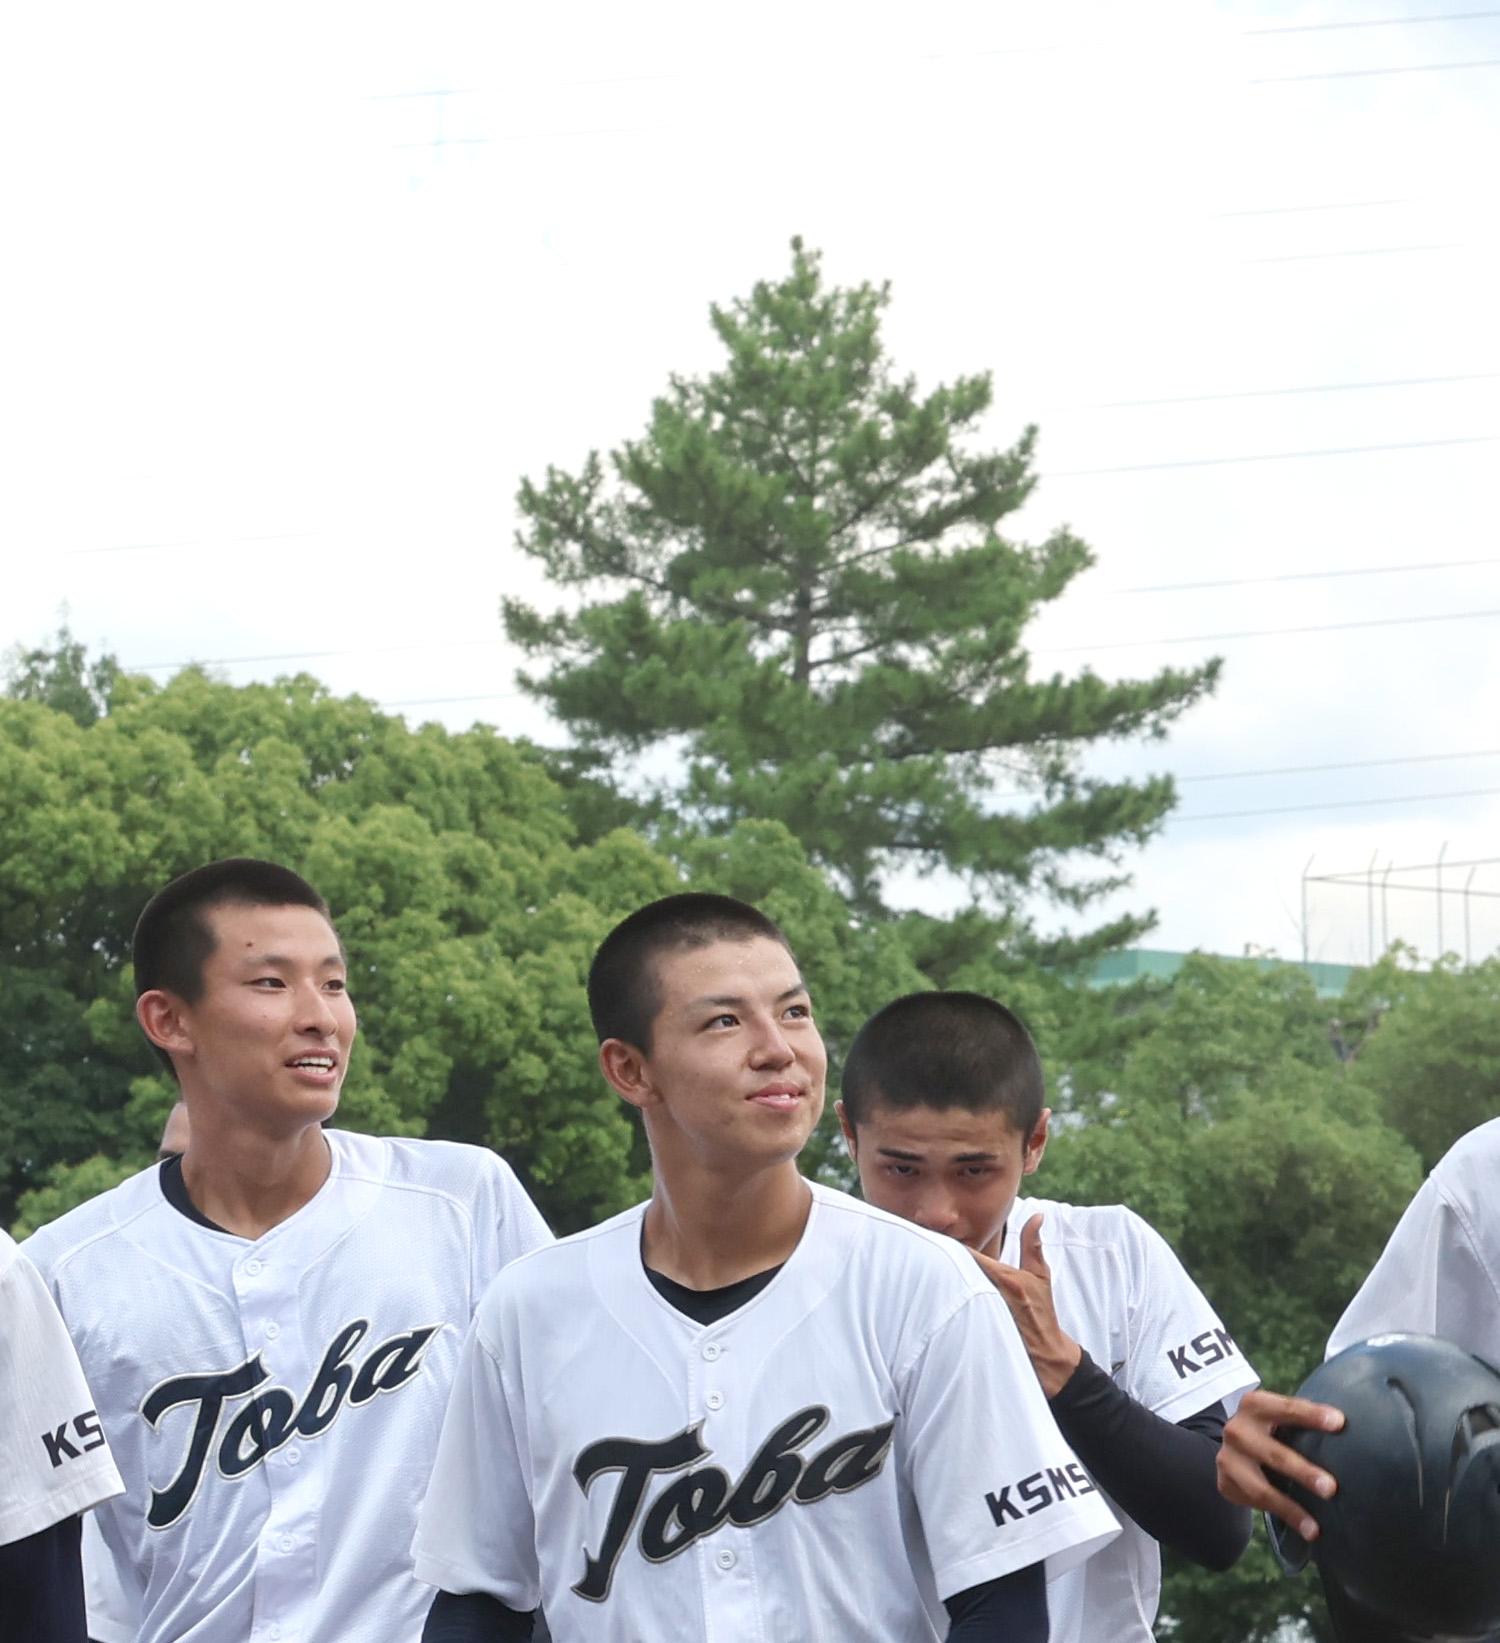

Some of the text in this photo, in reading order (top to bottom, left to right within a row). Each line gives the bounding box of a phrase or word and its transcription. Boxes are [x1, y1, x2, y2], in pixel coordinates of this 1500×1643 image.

[139, 1317, 444, 1531] Toba
[570, 1404, 900, 1603] Toba
[984, 1462, 1098, 1528] KSMS
